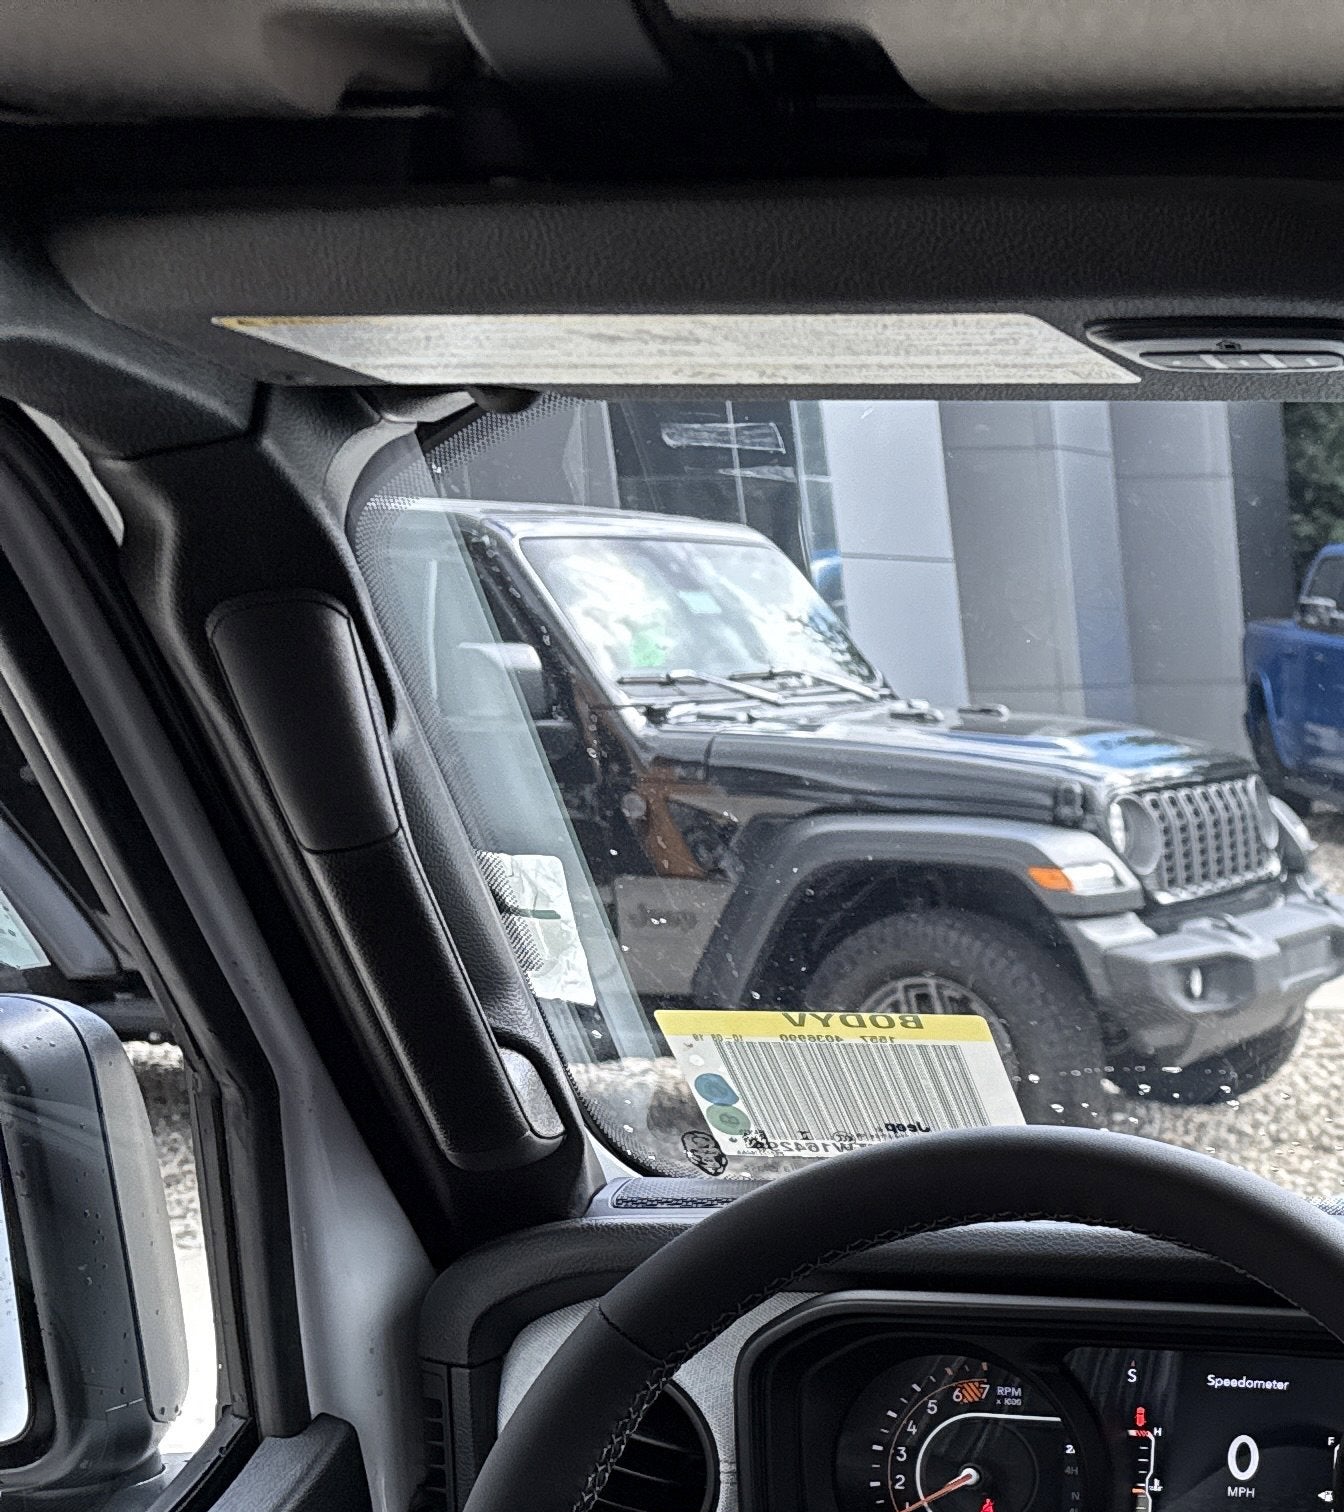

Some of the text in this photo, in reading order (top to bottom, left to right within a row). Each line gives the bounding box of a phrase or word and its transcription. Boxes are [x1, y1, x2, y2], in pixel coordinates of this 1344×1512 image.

[1126, 1368, 1138, 1383] S
[1206, 1373, 1290, 1391] Speedometer
[952, 1390, 963, 1402] 6
[997, 1386, 1022, 1397] RPM
[926, 1399, 938, 1415] 5
[906, 1420, 918, 1435] 4
[895, 1446, 907, 1462] 3
[1227, 1434, 1260, 1481] 0
[894, 1474, 906, 1490] 2
[1226, 1486, 1256, 1499] MPH
